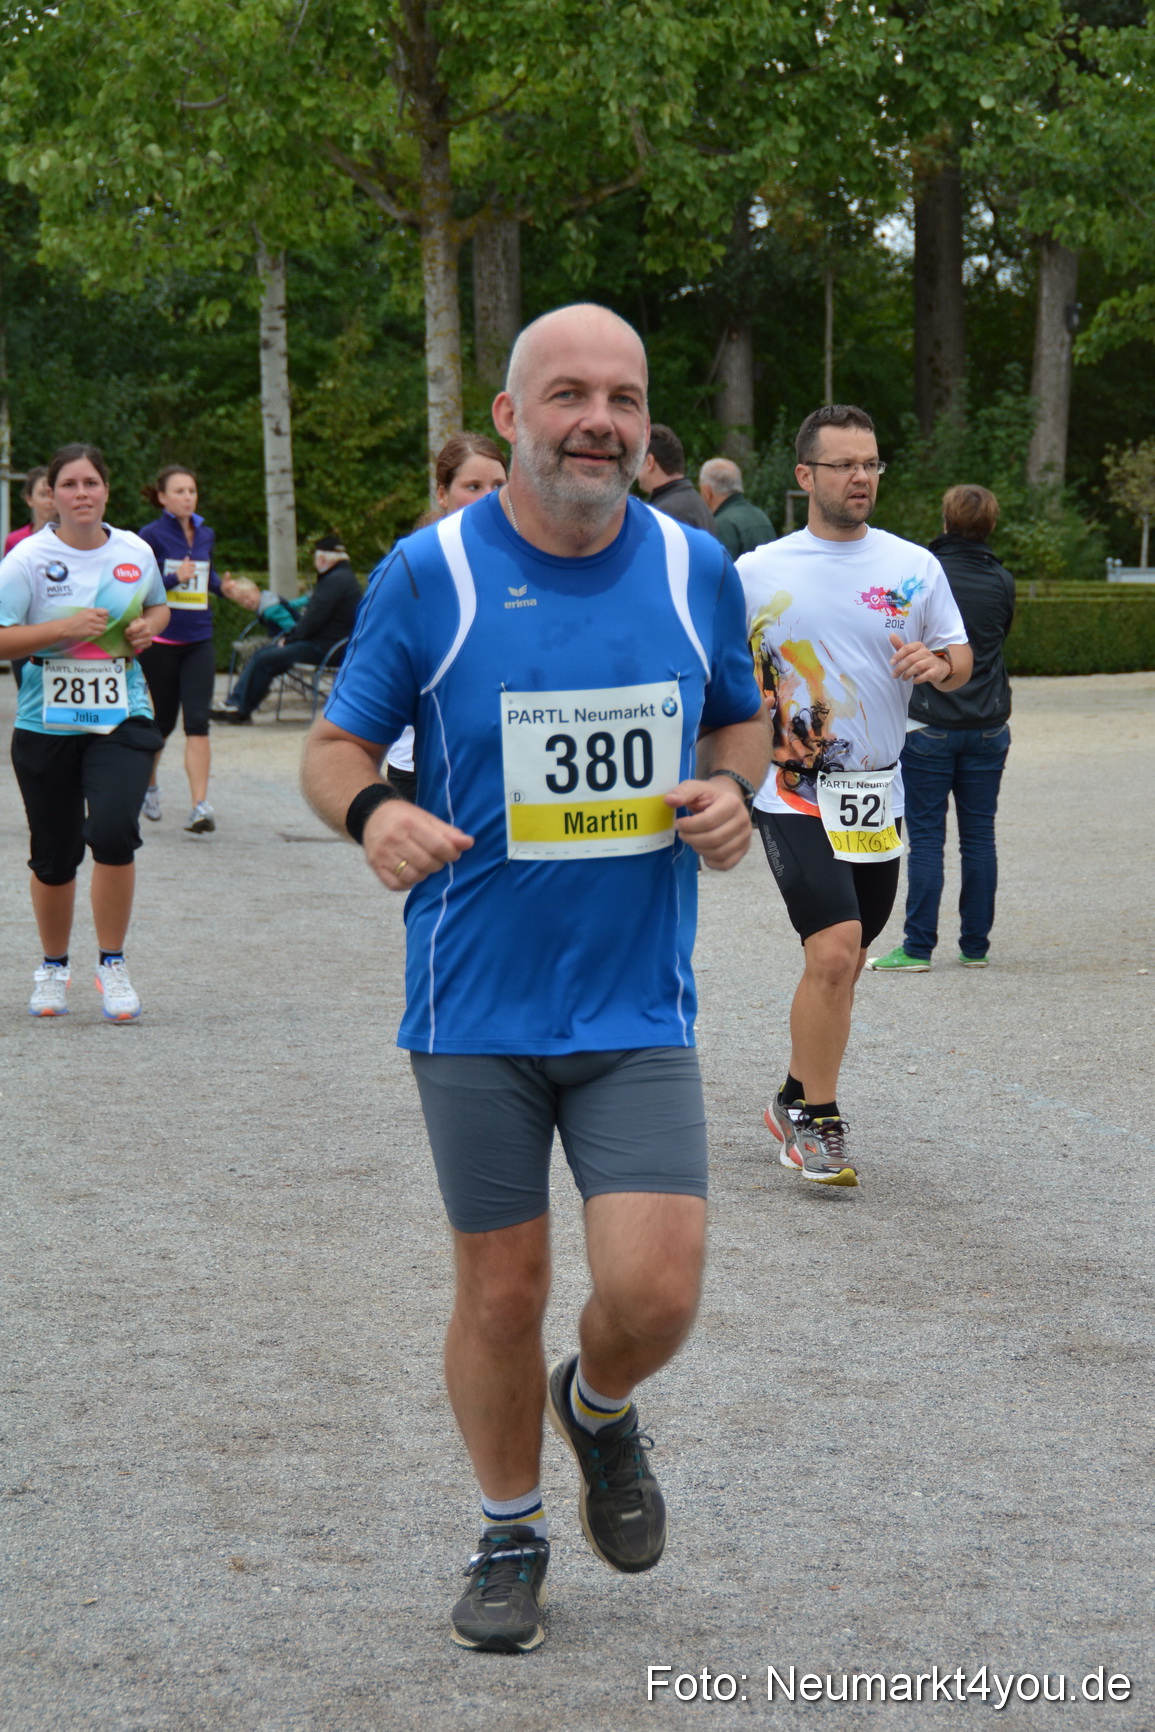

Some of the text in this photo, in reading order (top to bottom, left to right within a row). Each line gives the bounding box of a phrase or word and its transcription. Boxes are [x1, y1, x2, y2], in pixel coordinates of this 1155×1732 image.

[47, 585, 71, 593] PARTL
[504, 598, 537, 609] erima
[885, 618, 905, 629] 2012
[45, 664, 112, 674] PARTL Neumarkt
[53, 677, 119, 704] 2813
[73, 712, 99, 723] Julia
[507, 703, 656, 725] PARTL Neumarkt
[545, 728, 654, 794] 380
[820, 780, 854, 789] PARTL
[513, 792, 521, 803] D
[564, 808, 639, 835] Martin
